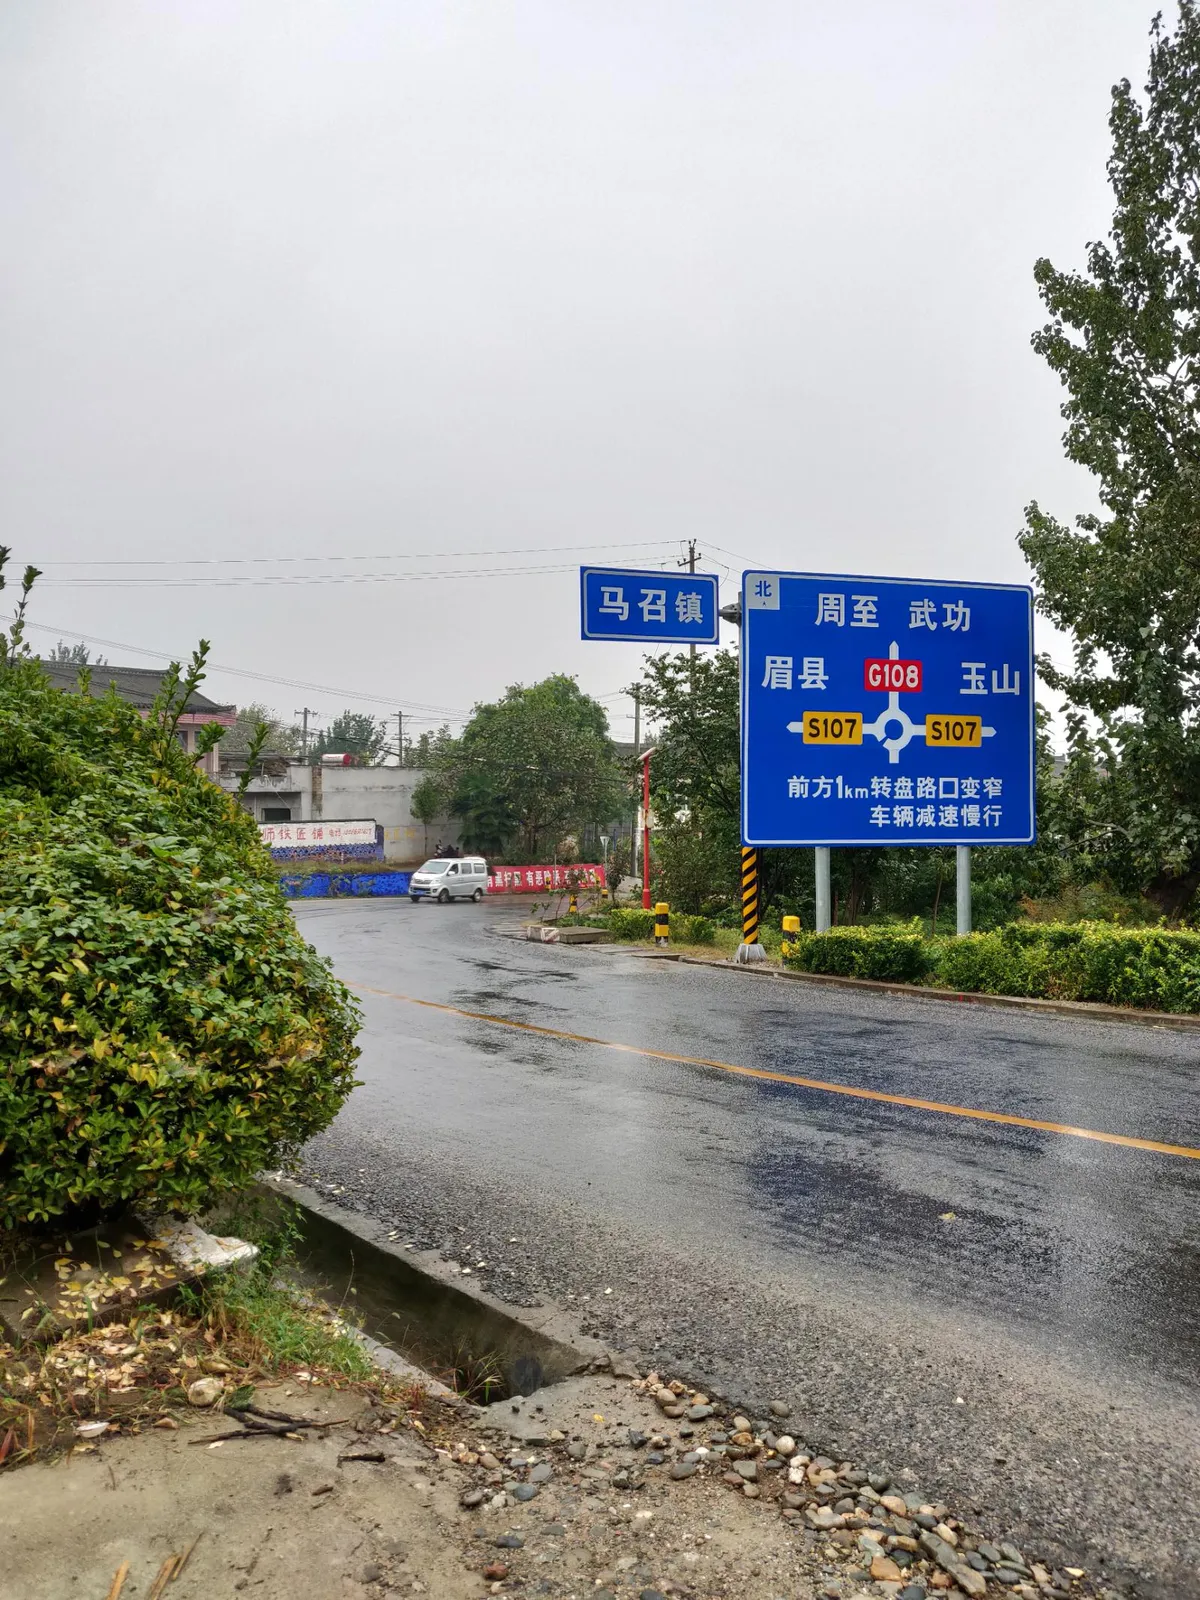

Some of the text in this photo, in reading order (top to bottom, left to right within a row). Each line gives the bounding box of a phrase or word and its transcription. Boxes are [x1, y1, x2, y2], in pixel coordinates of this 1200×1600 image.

[754, 581, 772, 598] 北
[599, 587, 703, 623] 马召镇
[815, 593, 971, 632] 周至 武功
[762, 655, 829, 690] 眉县
[868, 663, 919, 688] G108
[960, 662, 1020, 695] 玉山
[808, 718, 858, 739] S107
[931, 720, 978, 741] S107
[787, 775, 1003, 799] 前方1km转盘路口变窄
[869, 804, 1003, 828] 车辆减速慢行
